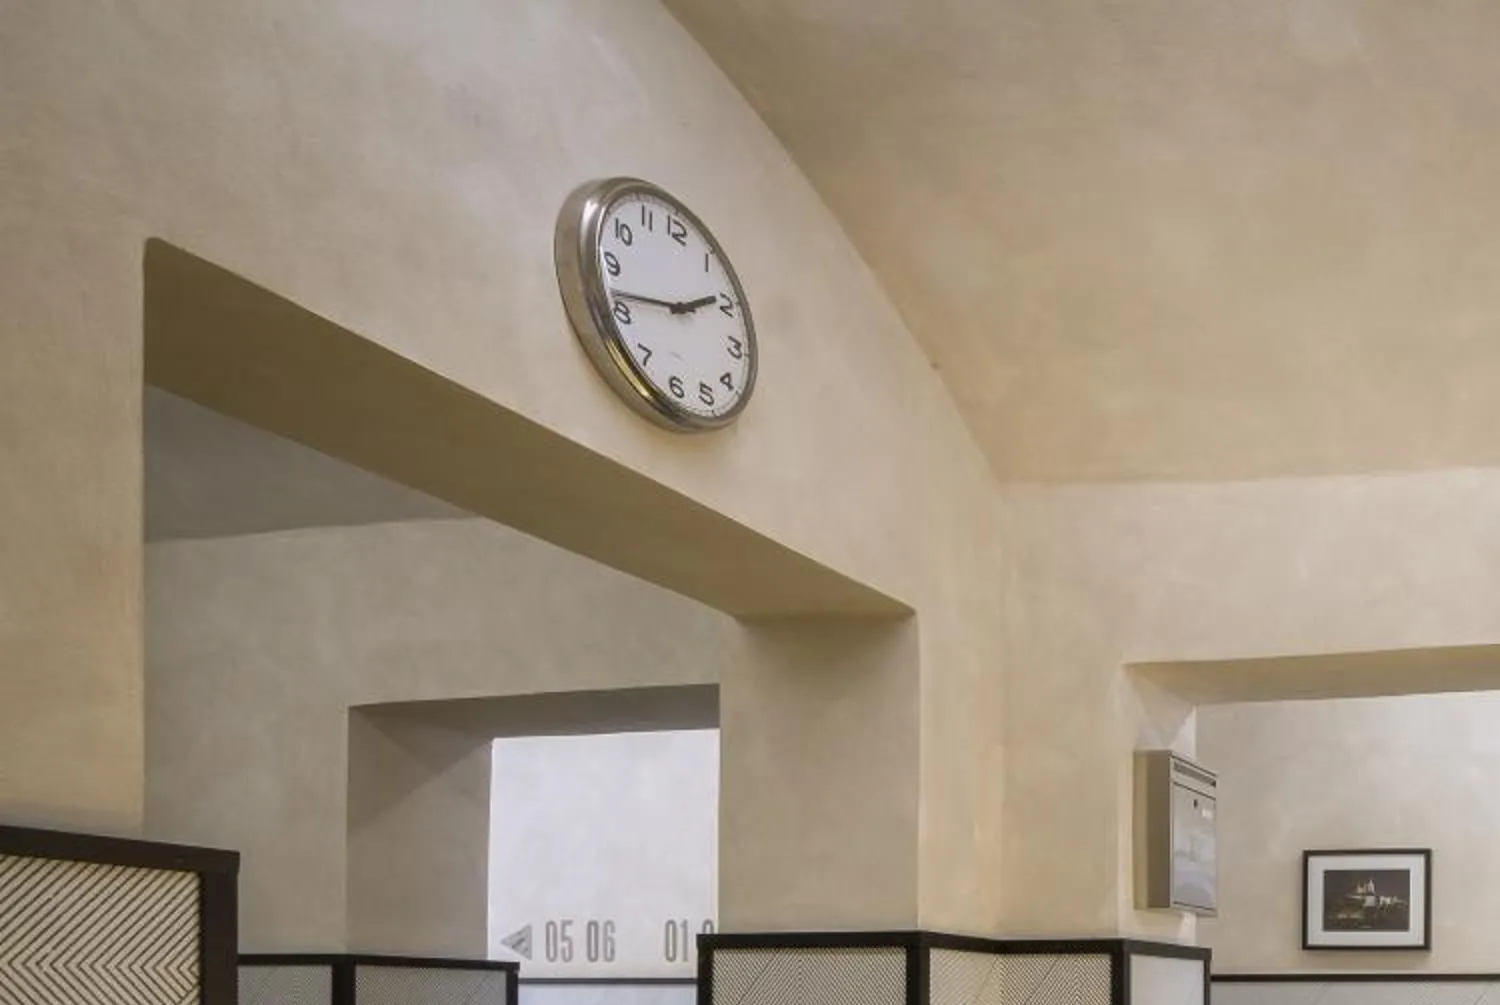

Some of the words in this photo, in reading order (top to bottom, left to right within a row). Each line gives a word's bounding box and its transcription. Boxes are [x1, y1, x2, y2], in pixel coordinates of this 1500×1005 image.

[641, 205, 653, 232] 11
[667, 215, 688, 246] 12
[615, 217, 633, 246] 10
[603, 252, 621, 277] 9
[613, 301, 631, 325] 8
[719, 292, 734, 318] 2
[637, 343, 652, 366] 7
[727, 335, 742, 360] 3
[669, 375, 685, 399] 6
[698, 383, 715, 406] 5
[719, 372, 733, 392] 4
[545, 919, 574, 963] 05
[586, 919, 616, 963] 06
[664, 919, 689, 963] 01
